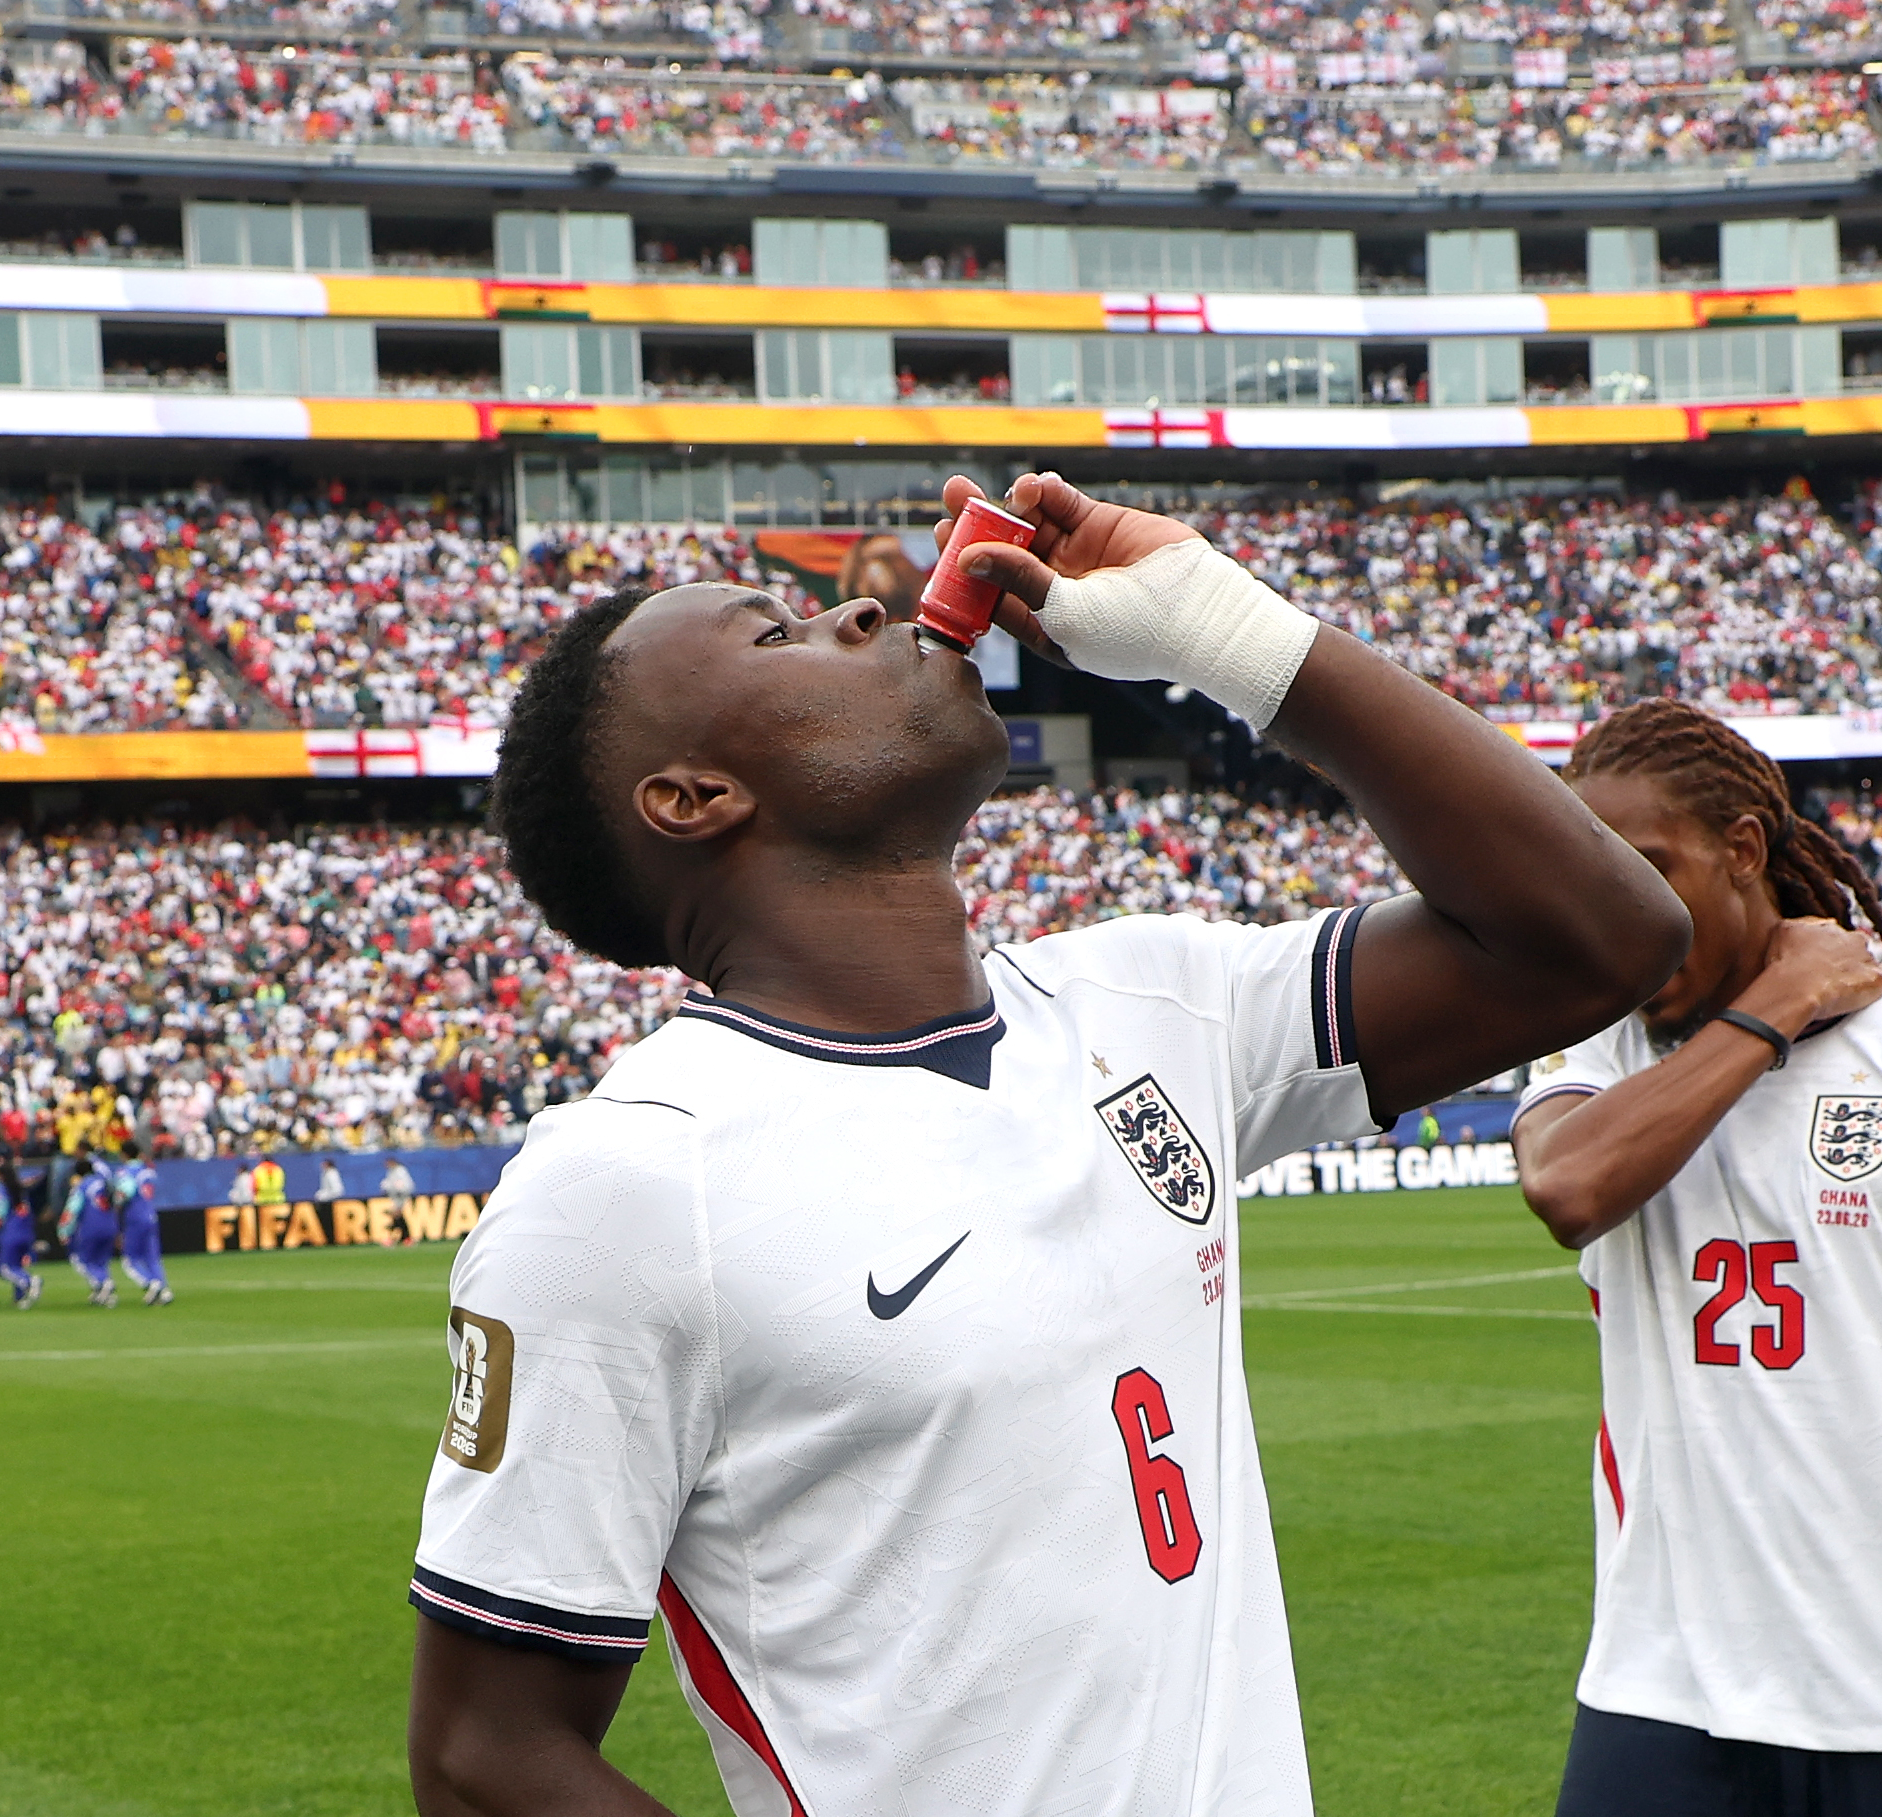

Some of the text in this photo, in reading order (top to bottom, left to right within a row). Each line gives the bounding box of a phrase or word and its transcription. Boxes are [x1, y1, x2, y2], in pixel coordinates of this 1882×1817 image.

[1313, 1146, 1397, 1194] THE
[1397, 1141, 1519, 1191] GAME
[204, 1193, 486, 1254] FIFA REWA
[1820, 1189, 1868, 1208] GHANA
[1196, 1237, 1225, 1274] GHAN
[1690, 1236, 1807, 1371] 25
[1109, 1366, 1204, 1585] 6
